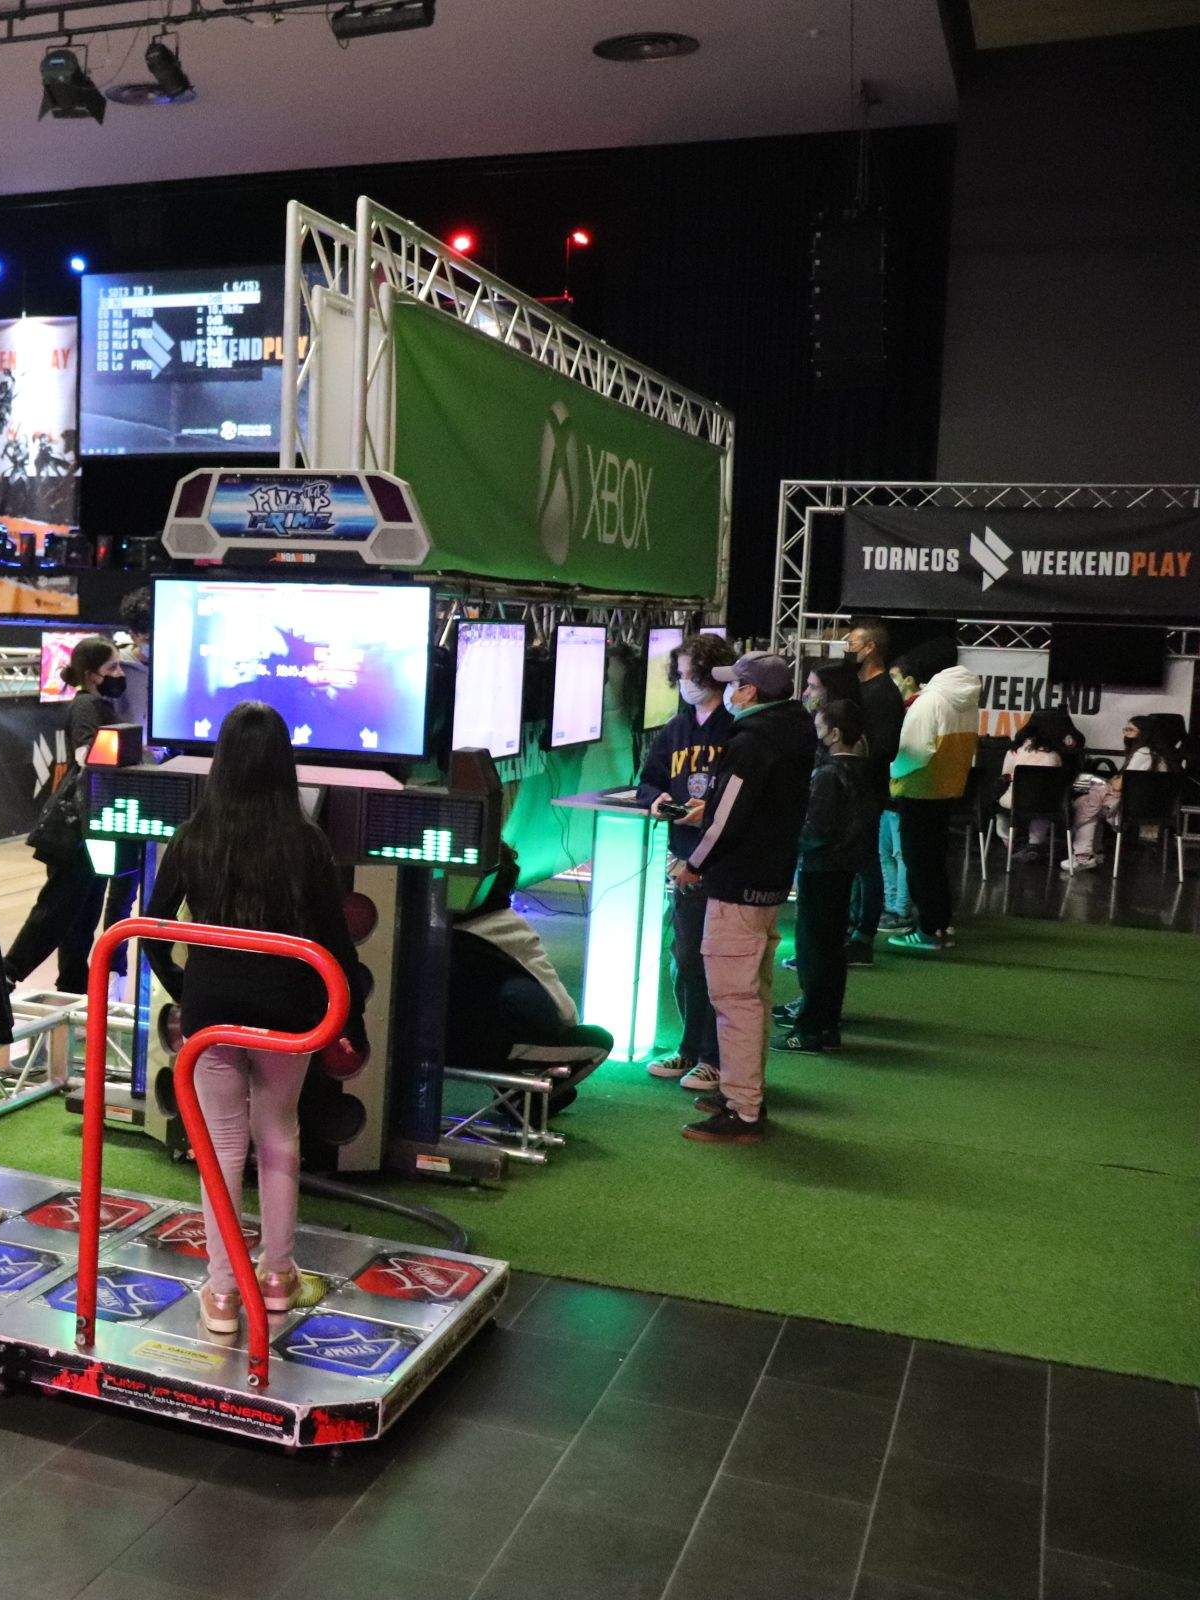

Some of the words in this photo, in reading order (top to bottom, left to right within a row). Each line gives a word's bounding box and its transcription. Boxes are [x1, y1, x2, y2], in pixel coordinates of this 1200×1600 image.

[581, 444, 653, 551] XBOX
[248, 510, 335, 536] PRIME
[862, 546, 960, 573] TORNEOS
[1021, 550, 1192, 577] WEEKENDPLAY
